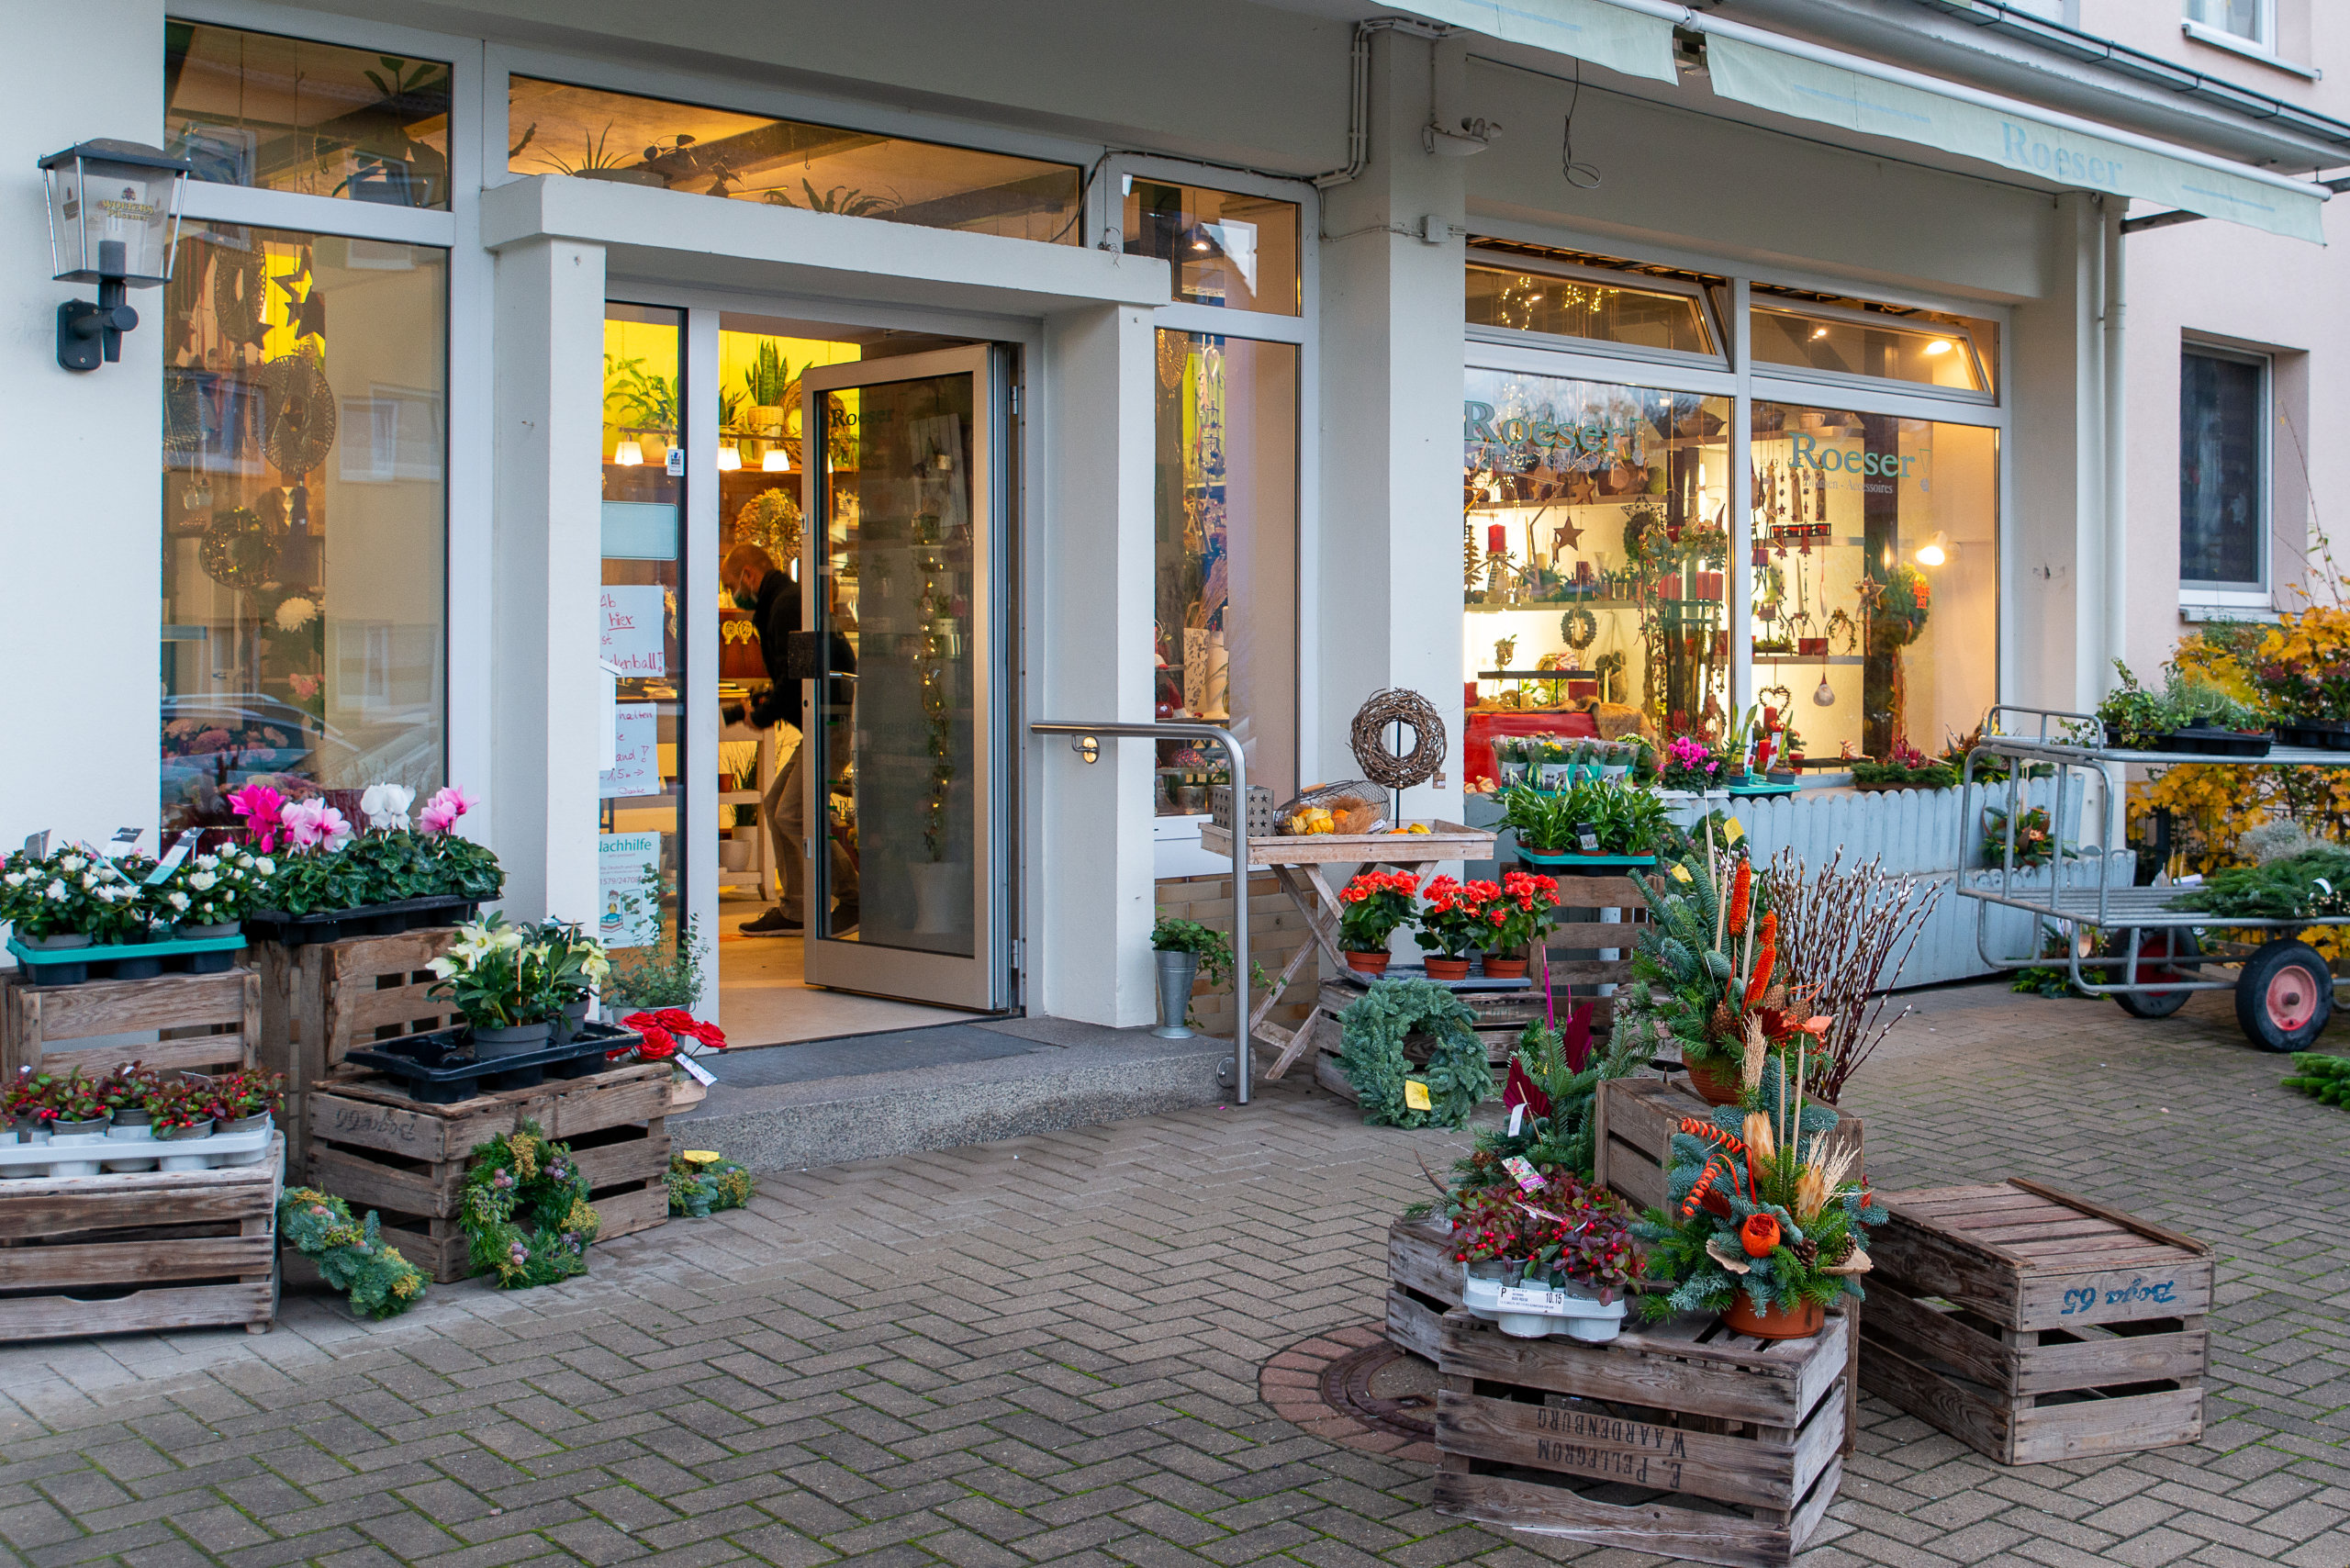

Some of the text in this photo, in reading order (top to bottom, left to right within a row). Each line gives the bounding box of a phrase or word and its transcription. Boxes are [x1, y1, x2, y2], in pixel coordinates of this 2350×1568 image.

[2000, 120, 2123, 188] Roeser
[1464, 400, 1624, 452] Roeser
[1788, 432, 1916, 477] Roeser
[1846, 478, 1893, 494] Accessoires
[609, 612, 634, 626] hier
[1500, 1287, 1507, 1298] P
[1545, 1292, 1562, 1305] 10.15
[2061, 1278, 2177, 1315] Boga 65
[1538, 1408, 1687, 1459] WAARDENBURG
[1538, 1438, 1683, 1489] E. PELLEGROM
